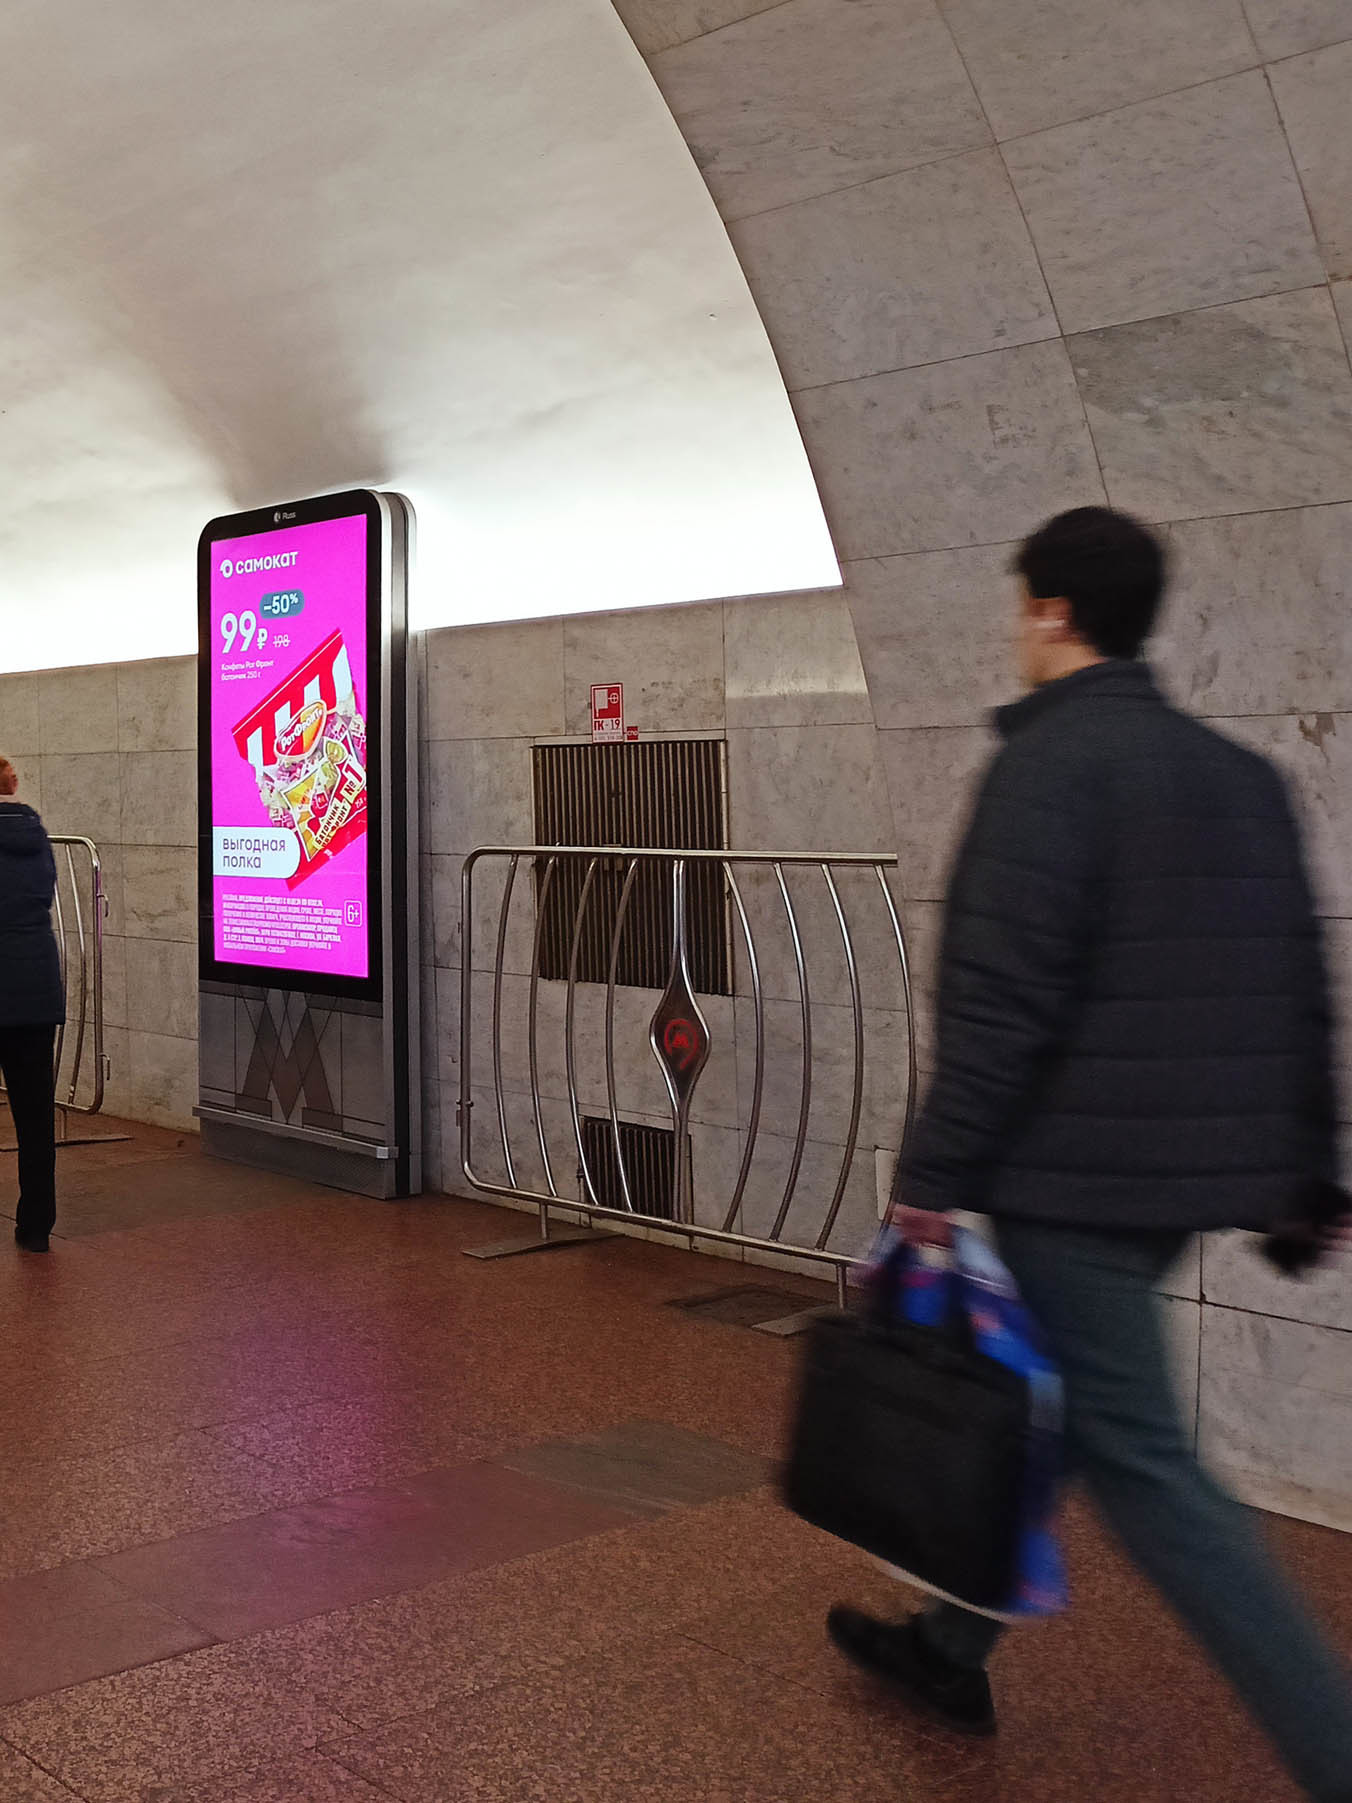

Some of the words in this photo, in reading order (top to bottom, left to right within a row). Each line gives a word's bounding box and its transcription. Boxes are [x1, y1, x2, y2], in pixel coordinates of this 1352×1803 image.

[236, 551, 298, 574] самокат
[263, 593, 298, 614] -50%
[315, 804, 339, 845] БАТОНЧИК
[222, 838, 286, 852] выгодная
[222, 855, 261, 869] полка
[347, 904, 360, 922] 6+
